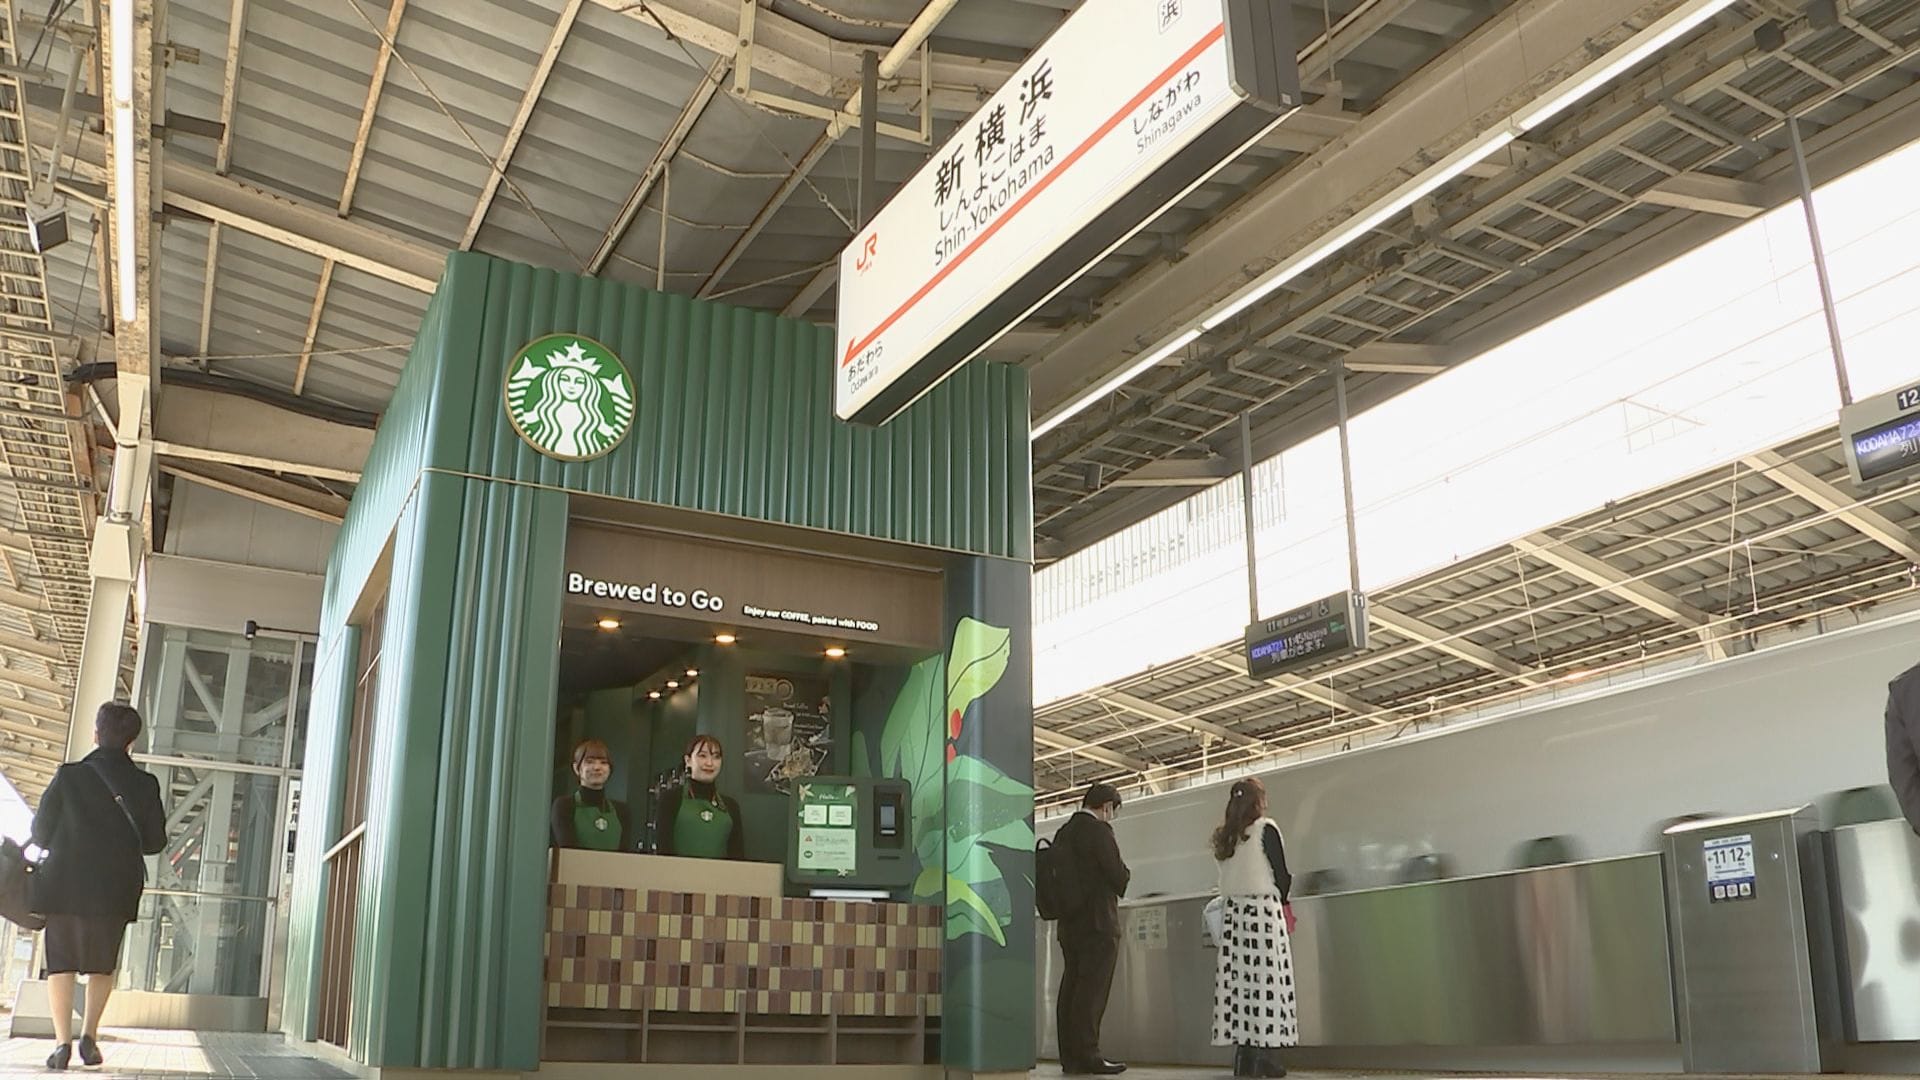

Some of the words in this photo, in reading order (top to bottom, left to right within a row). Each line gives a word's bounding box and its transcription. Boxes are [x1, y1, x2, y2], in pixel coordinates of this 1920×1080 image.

[1133, 70, 1200, 135] しながわ
[934, 58, 1053, 207] 新横浜
[1136, 94, 1201, 154] Shinagawa
[939, 114, 1047, 232] しんよこはま
[934, 144, 1054, 266] Shin-Yokohama
[857, 231, 877, 271] JR
[848, 340, 883, 382] おだわら
[1899, 389, 1919, 408] 12
[568, 572, 657, 603] Brewed
[662, 587, 687, 606] to
[691, 590, 724, 611] Go
[1353, 595, 1364, 607] 11
[743, 605, 766, 618] Enjoy
[766, 610, 780, 618] our
[781, 610, 811, 623] COFFEE,
[811, 616, 837, 625] paired
[838, 619, 856, 628] with
[856, 620, 879, 631] FOOD
[1713, 850, 1726, 865] 11
[1729, 847, 1745, 862] 12
